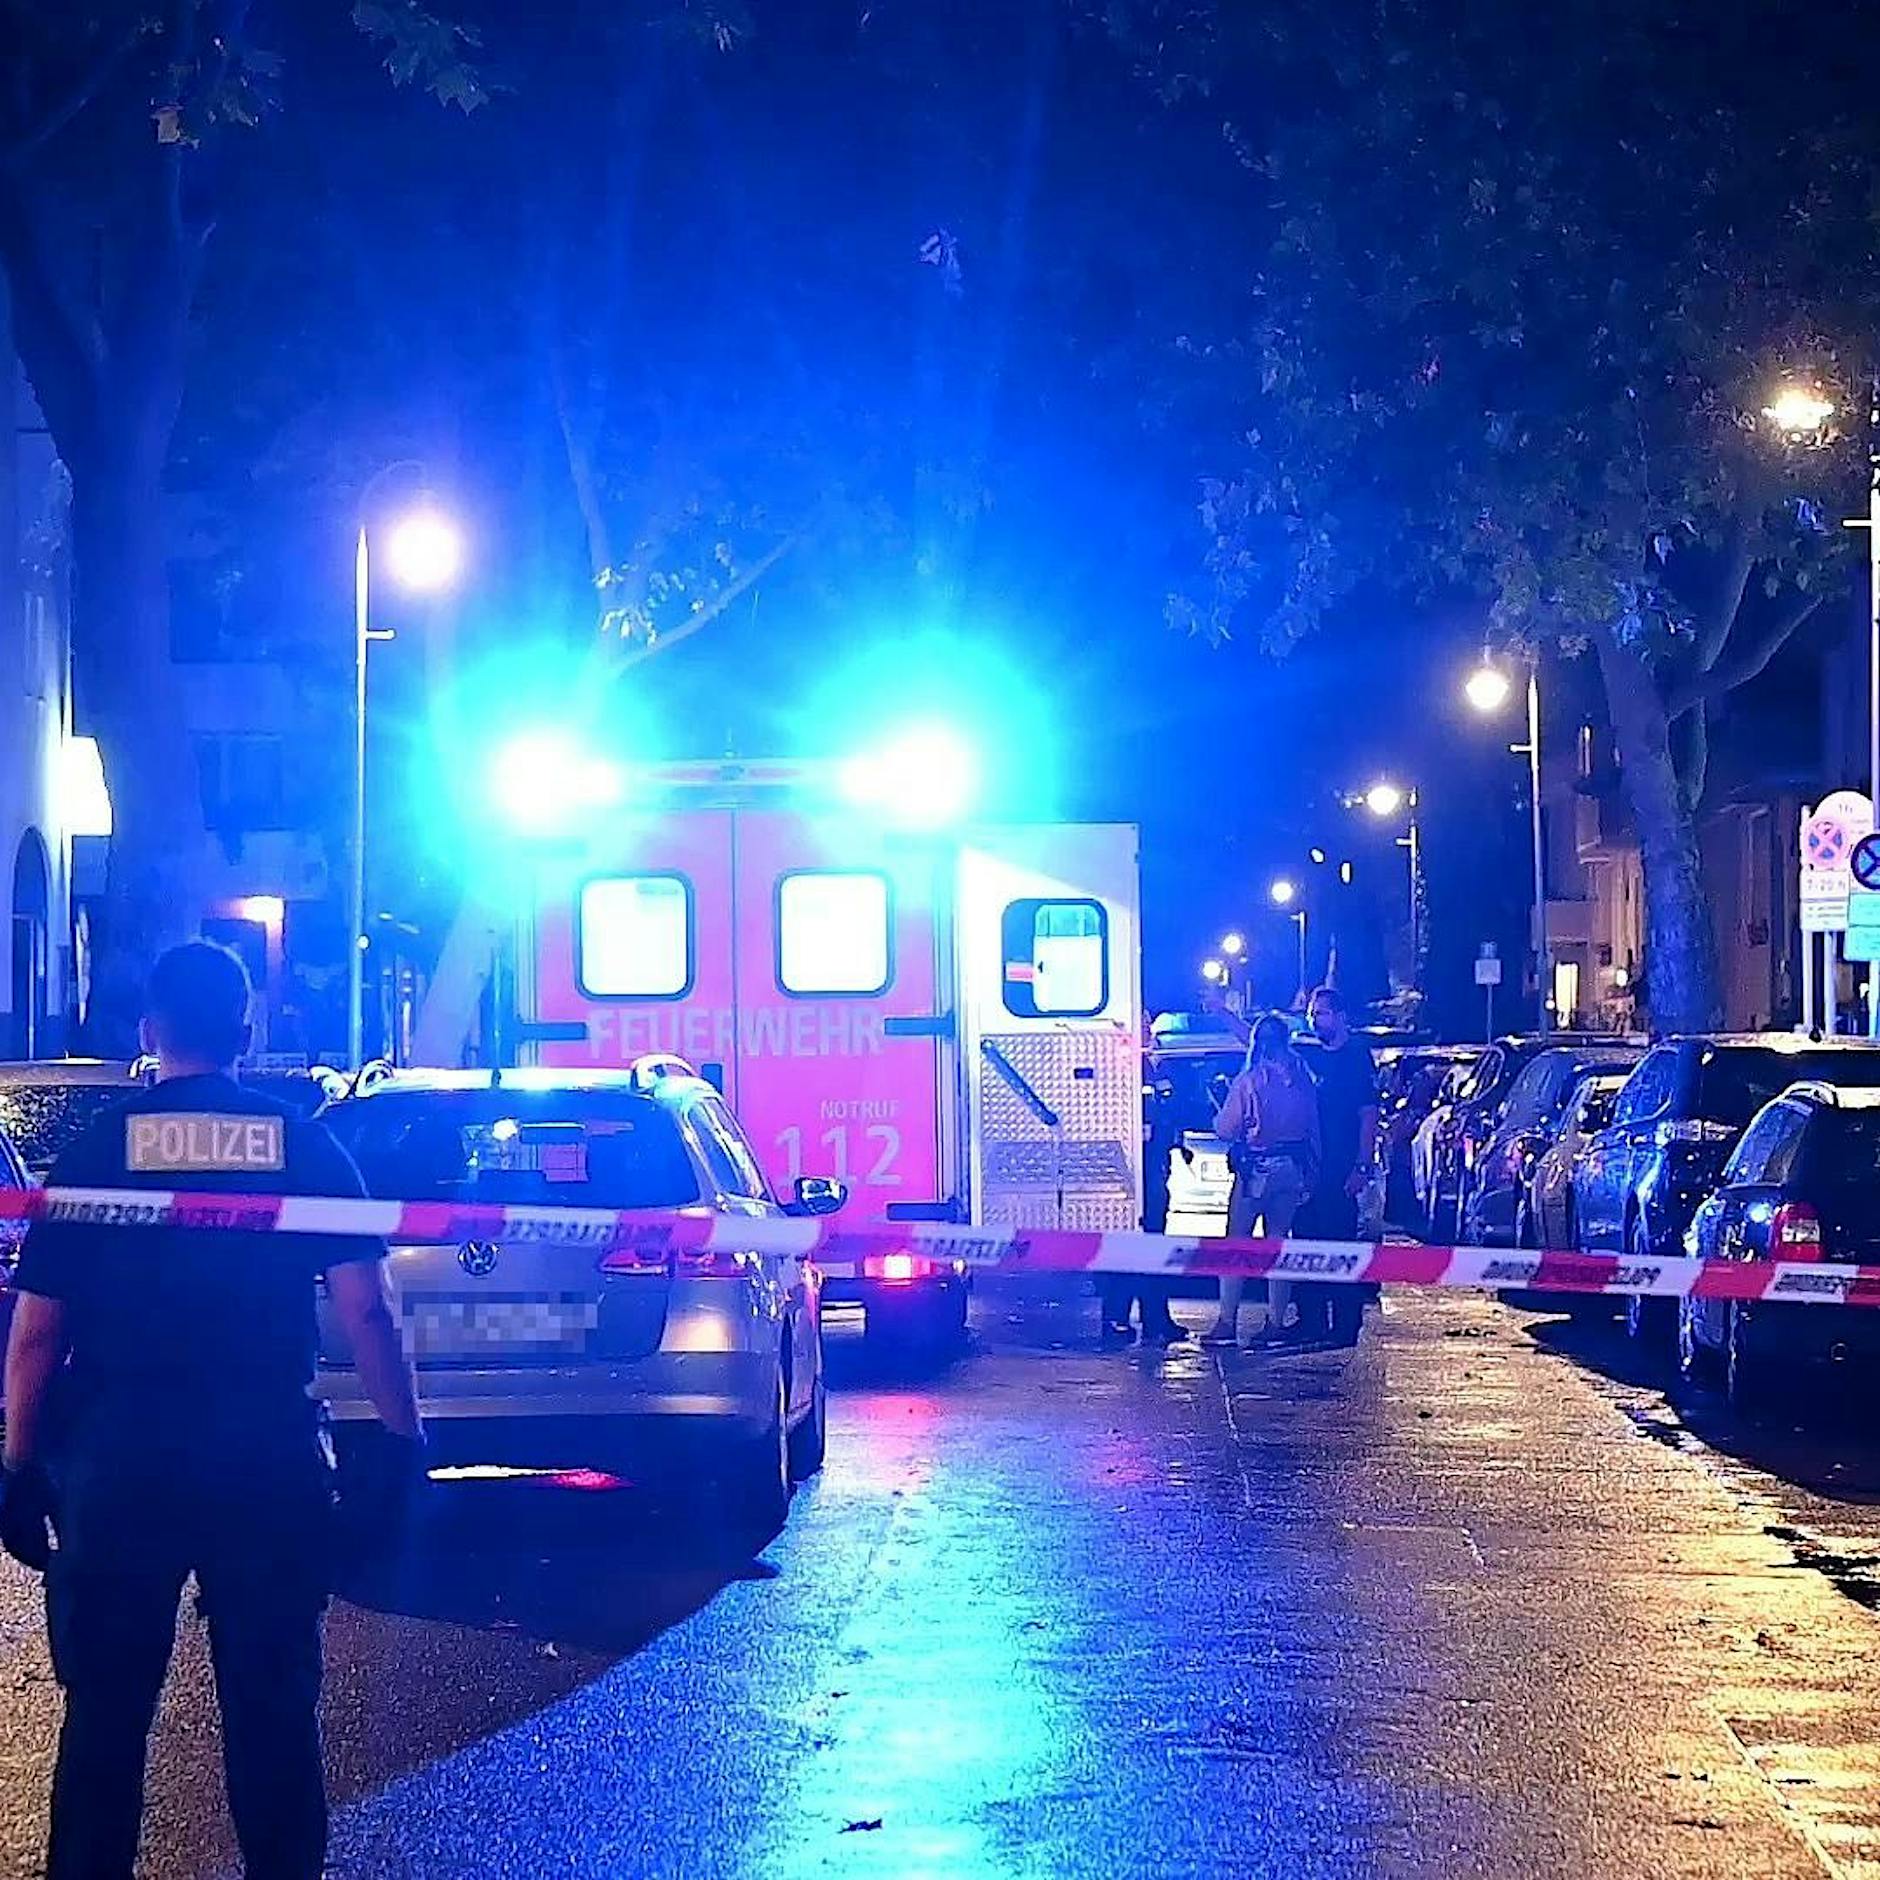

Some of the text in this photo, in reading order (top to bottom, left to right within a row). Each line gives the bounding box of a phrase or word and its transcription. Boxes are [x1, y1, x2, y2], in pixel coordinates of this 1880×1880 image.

[588, 1005, 883, 1058] FEUERWEHR
[820, 1099, 900, 1119] NOTRUF
[134, 1120, 277, 1164] POLIZEI
[776, 1125, 902, 1188] 112
